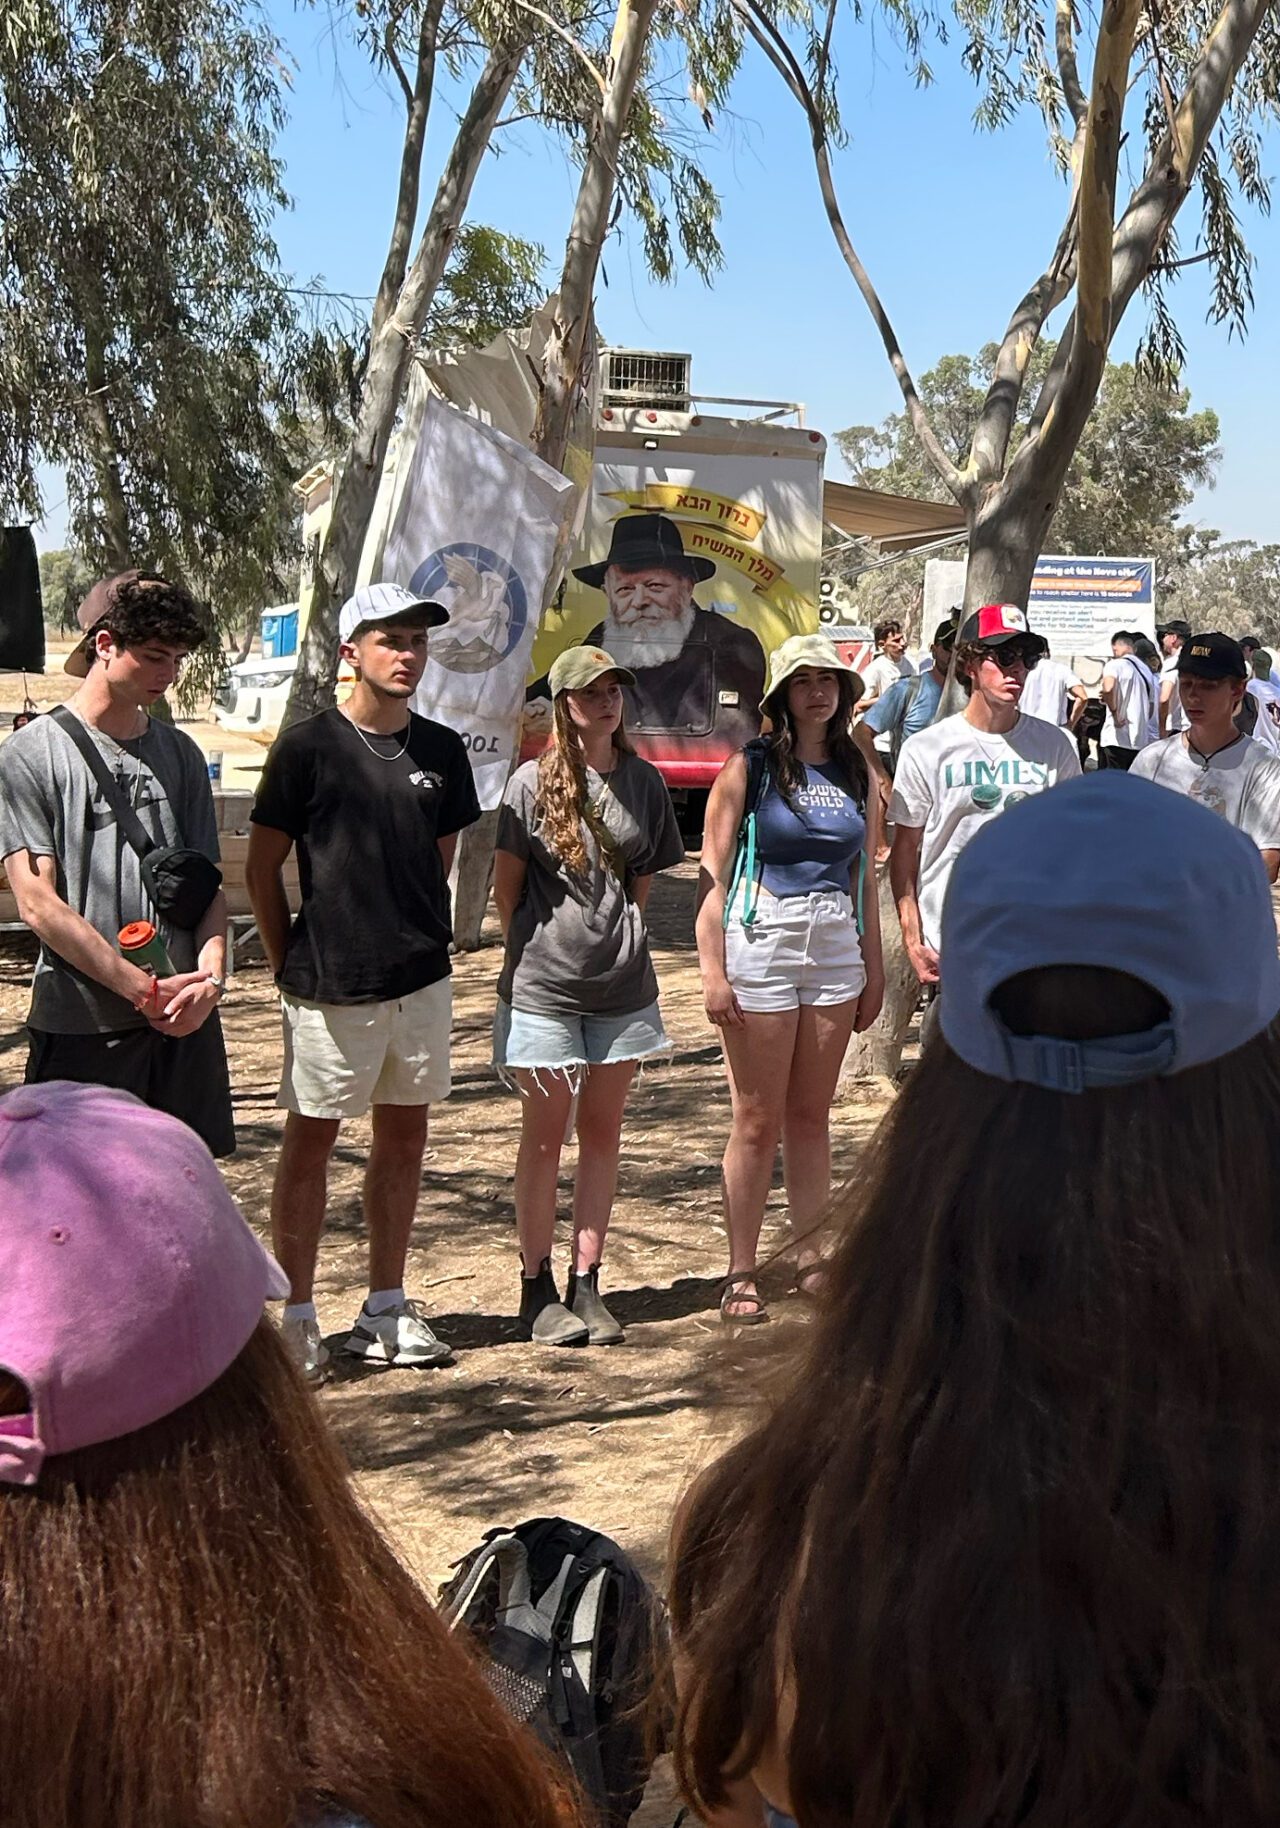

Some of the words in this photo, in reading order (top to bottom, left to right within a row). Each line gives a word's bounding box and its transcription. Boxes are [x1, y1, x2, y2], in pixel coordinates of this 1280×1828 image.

[676, 494, 712, 512] הבא
[717, 502, 751, 528] ברוך
[692, 534, 745, 563] המשיח
[747, 556, 775, 581] מלך
[945, 760, 1048, 789] LIMES
[798, 795, 844, 808] CHILD
